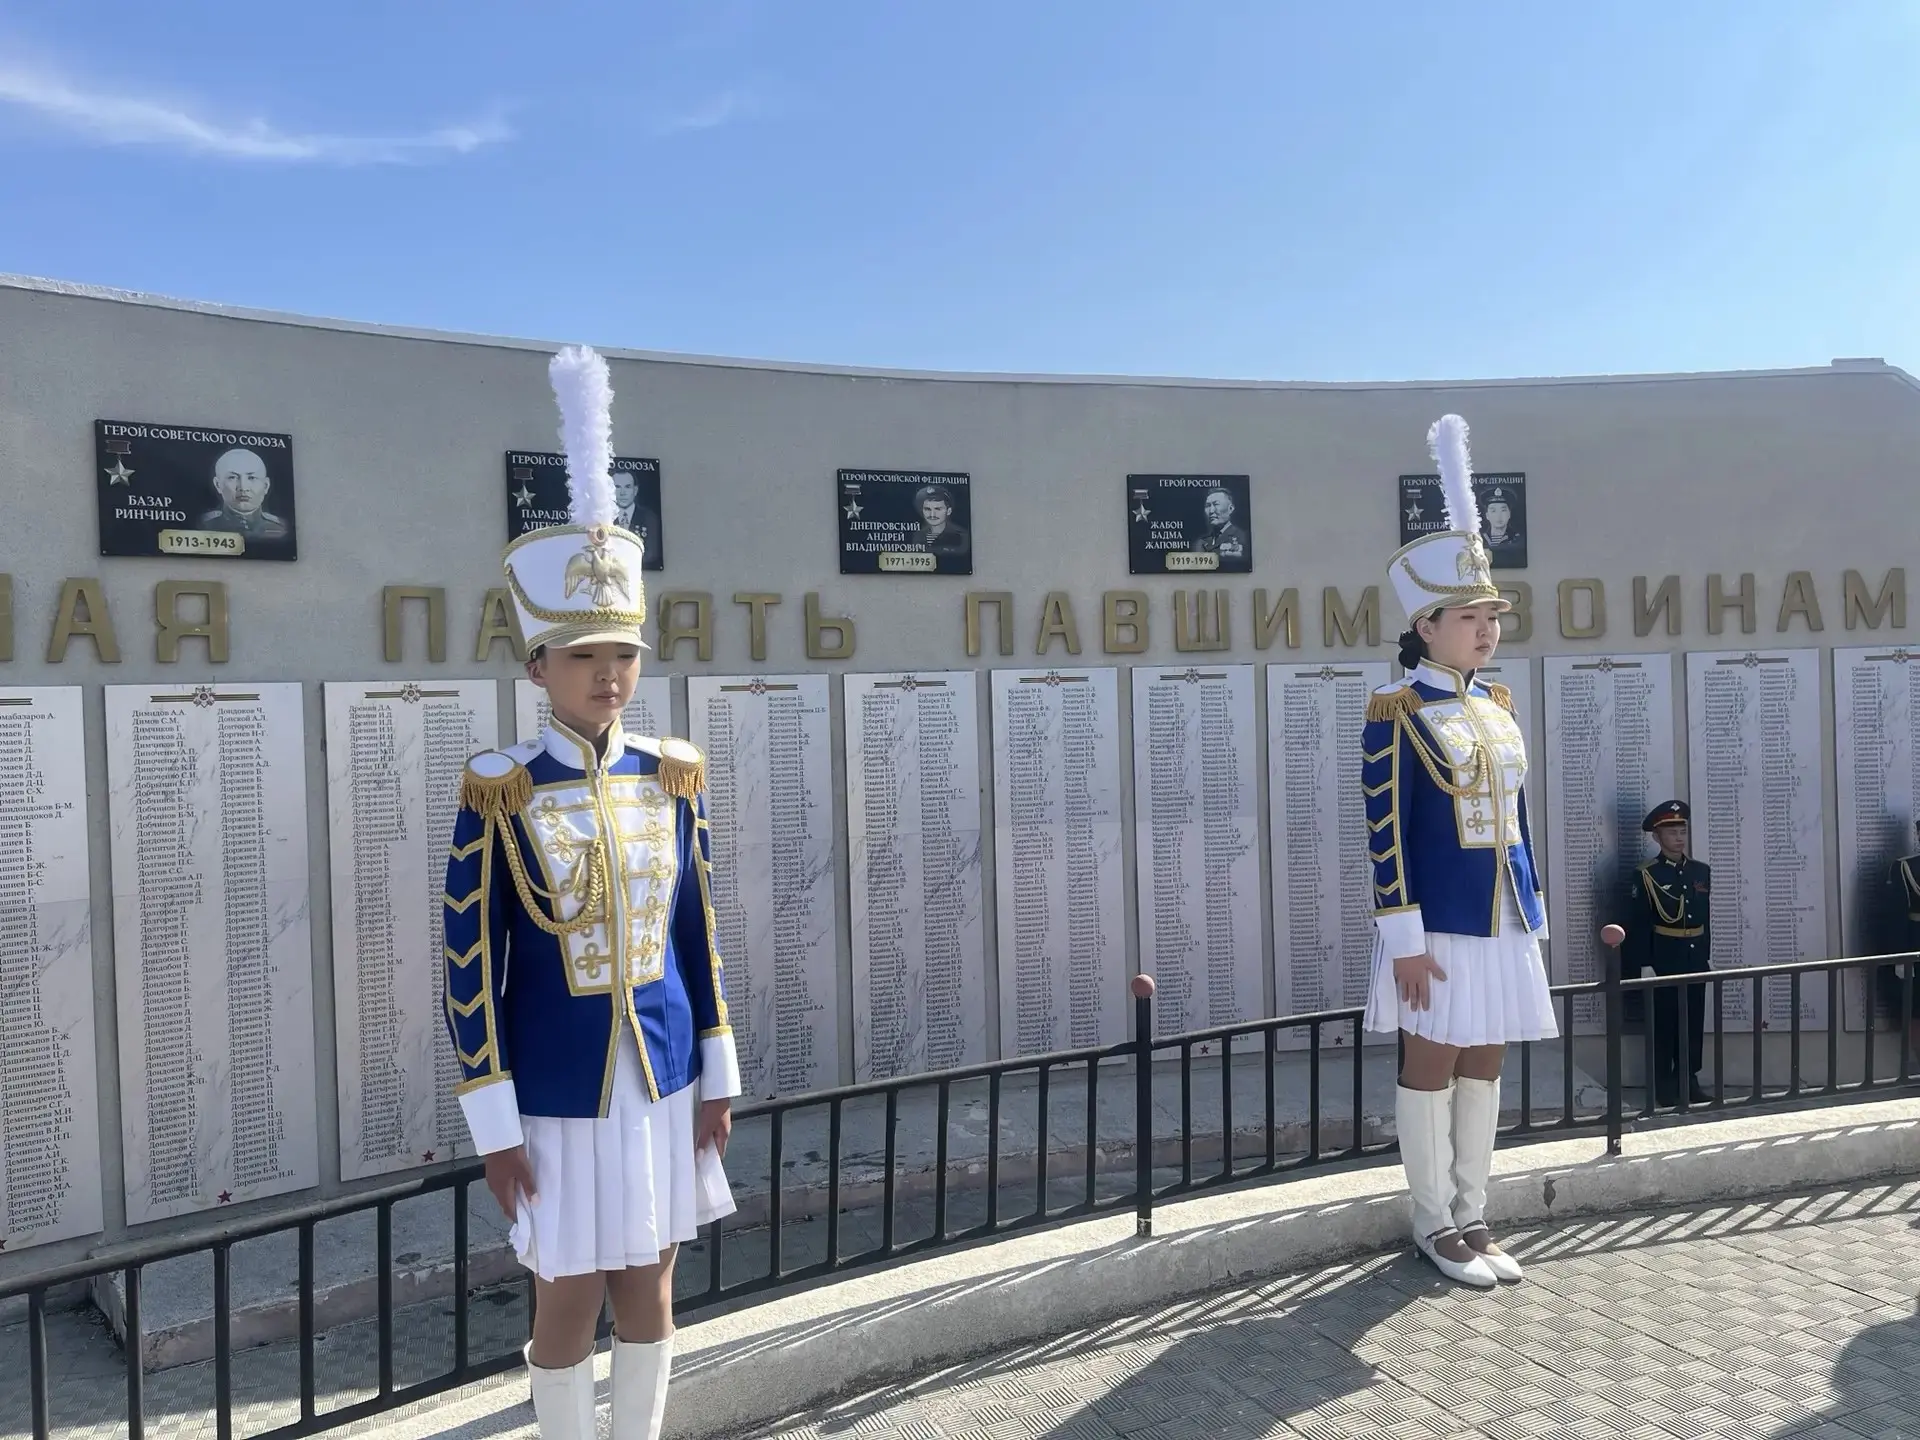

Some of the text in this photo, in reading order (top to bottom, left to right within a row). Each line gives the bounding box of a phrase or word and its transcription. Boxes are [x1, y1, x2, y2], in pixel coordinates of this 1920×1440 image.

[104, 424, 286, 449] ГЕРОЙ СОВЕТСКОГО СОЮЗА
[512, 454, 546, 466] ГЕРОЙ
[617, 461, 655, 472] СОЮЗА
[841, 473, 968, 485] ГЕРОЙ РОССИЙСКОЙ ФЕДЕРАЦИИ
[1159, 478, 1221, 488] ГЕРОЙ РОССИИ
[1403, 478, 1427, 487] ГЕРОЙ
[1479, 476, 1524, 485] ФЕДЕРАЦИИ
[128, 495, 172, 507] БАЗАР
[115, 508, 187, 522] РИНЧИНО
[850, 521, 921, 531] ДНЕПРОВСКИЙ
[1150, 521, 1183, 530] ЖАБОН
[867, 531, 905, 542] АНДРЕЙ
[1151, 531, 1183, 540] БАДМА
[168, 536, 236, 549] 1913-1943
[846, 542, 926, 552] ВЛАДИМИРОВИЧ
[1145, 541, 1190, 550] ЖАПОВИЧ
[885, 557, 931, 567] 1971-1995
[1171, 556, 1214, 566] 1919-1996
[0, 572, 228, 663] АЯ
[384, 585, 857, 662] ПАЯТЬ
[965, 586, 1381, 656] ПАВШИМ
[2, 1104, 47, 1116] Дементьев
[3, 1111, 52, 1125] Дементьева
[3, 1120, 52, 1133] Дементьева
